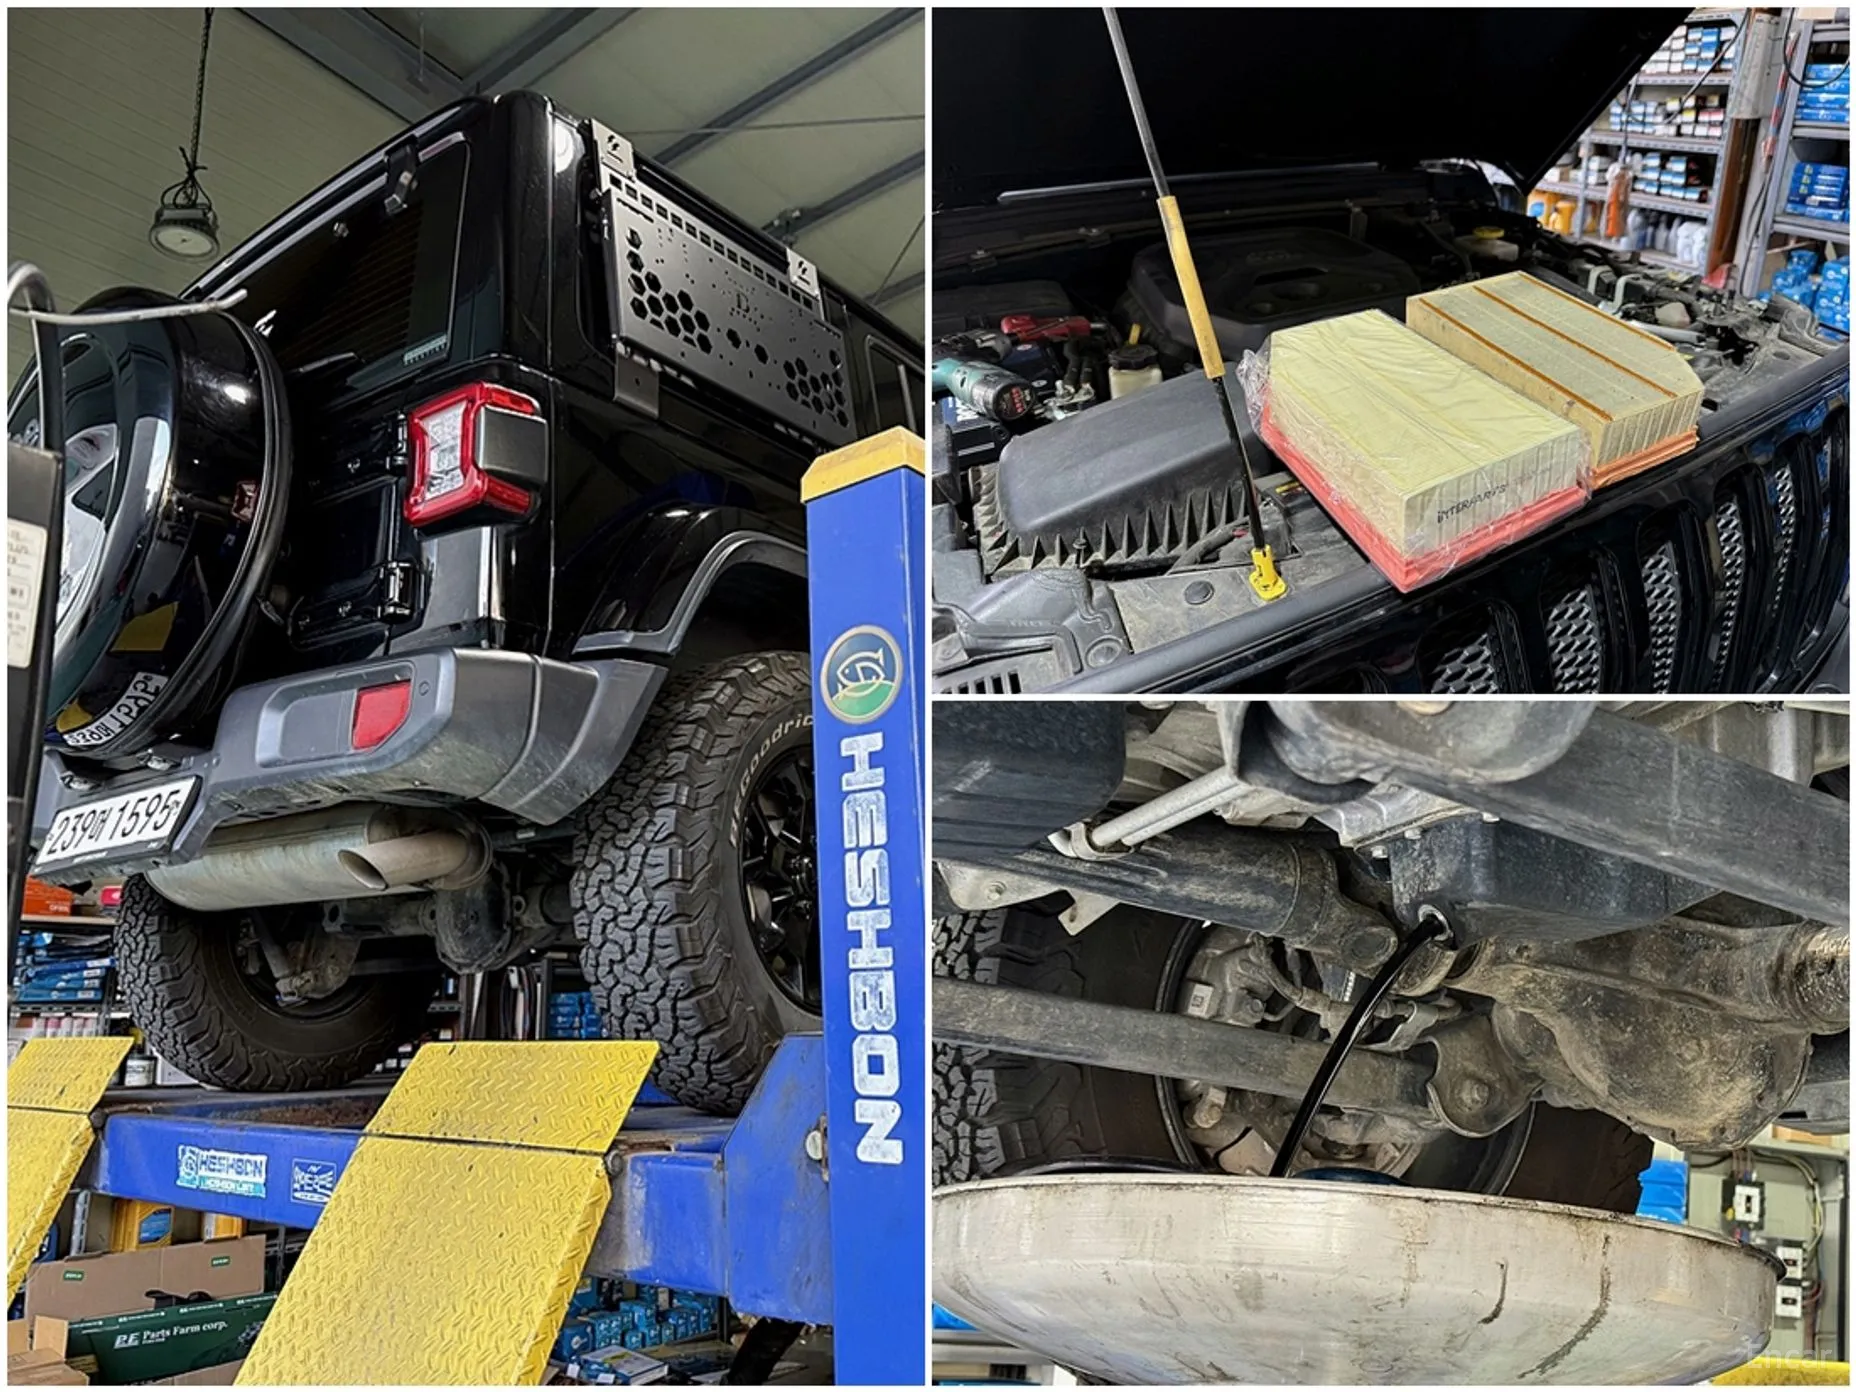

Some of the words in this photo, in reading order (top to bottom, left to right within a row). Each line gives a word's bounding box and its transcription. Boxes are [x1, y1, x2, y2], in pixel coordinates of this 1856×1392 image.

[840, 731, 904, 1165] HESHBON
[142, 1327, 171, 1341] Parts
[172, 1322, 201, 1336] Farm
